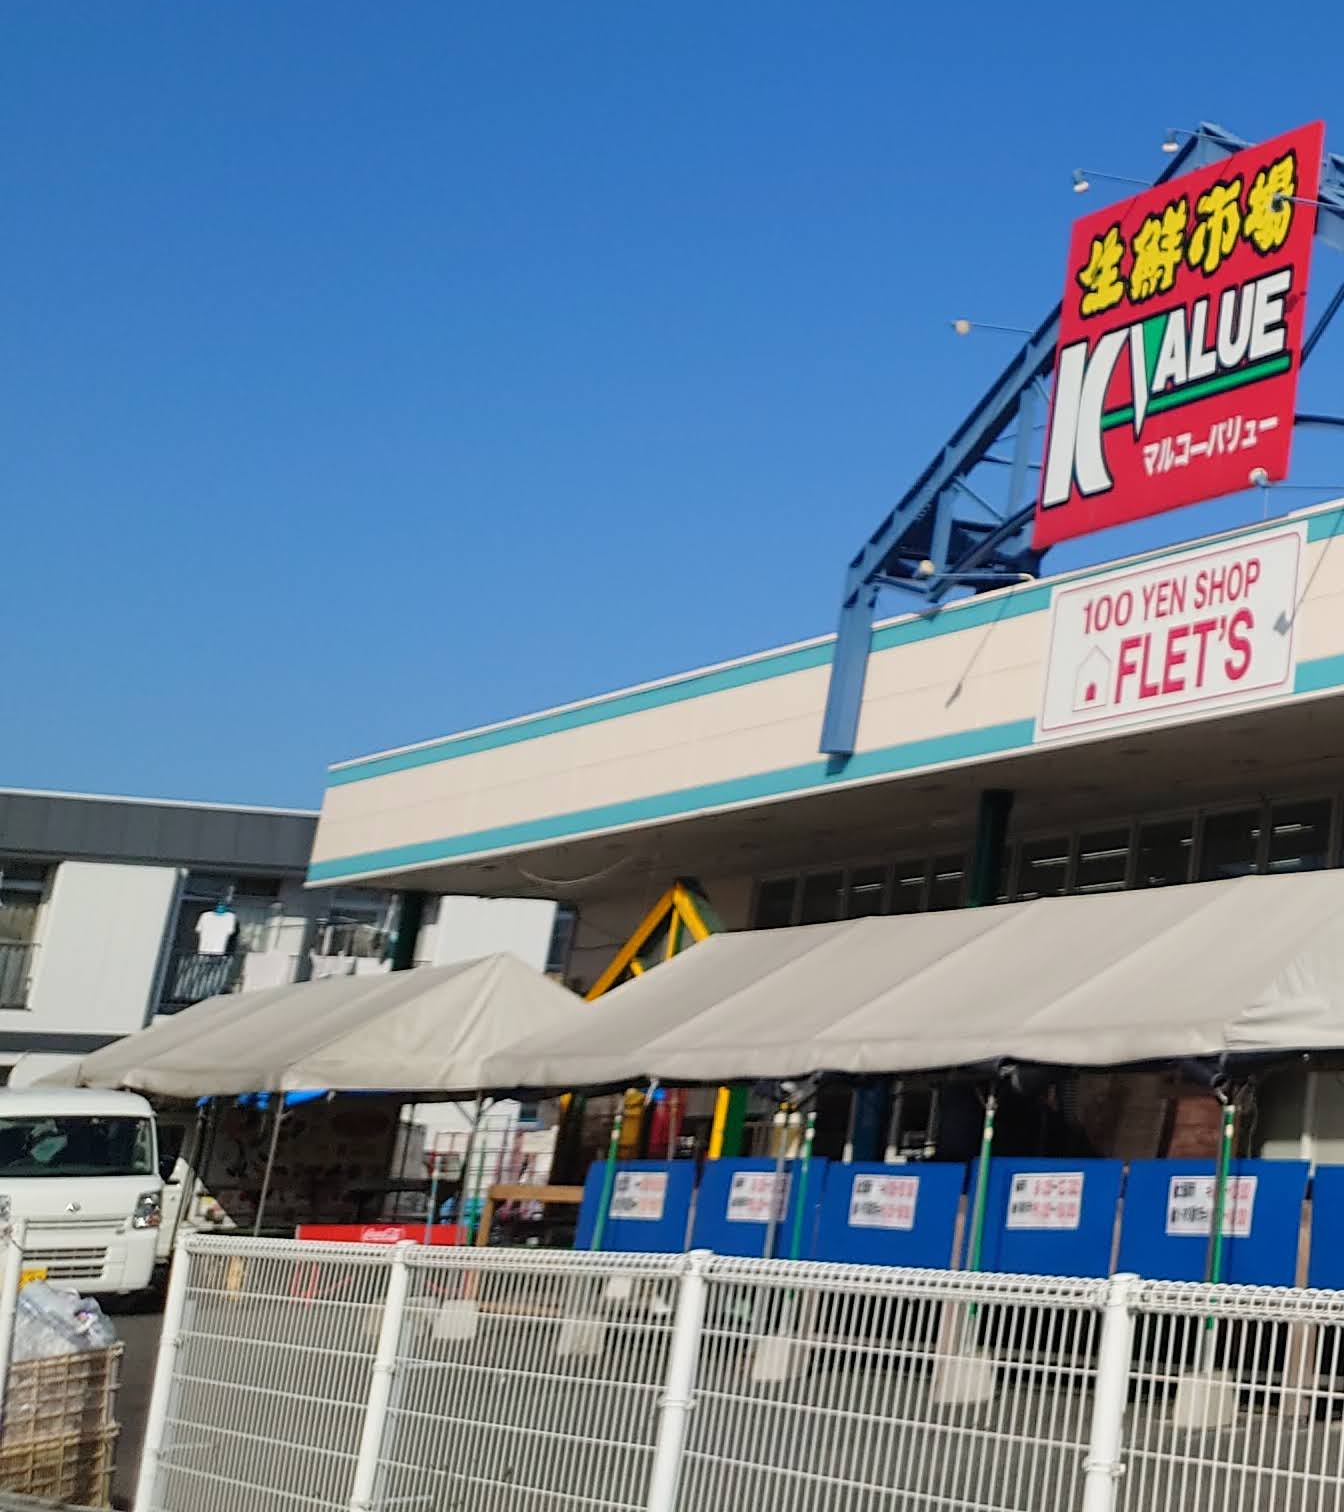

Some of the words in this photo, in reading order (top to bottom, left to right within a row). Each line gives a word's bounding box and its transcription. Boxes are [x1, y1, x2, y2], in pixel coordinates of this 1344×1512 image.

[1079, 153, 1296, 317] 生鮮市場
[1142, 416, 1280, 476] マルコーバリュー
[1083, 590, 1134, 635] 100
[1142, 575, 1188, 621] YEN
[1193, 557, 1261, 610] SHOP
[1114, 606, 1254, 704] FLET'S
